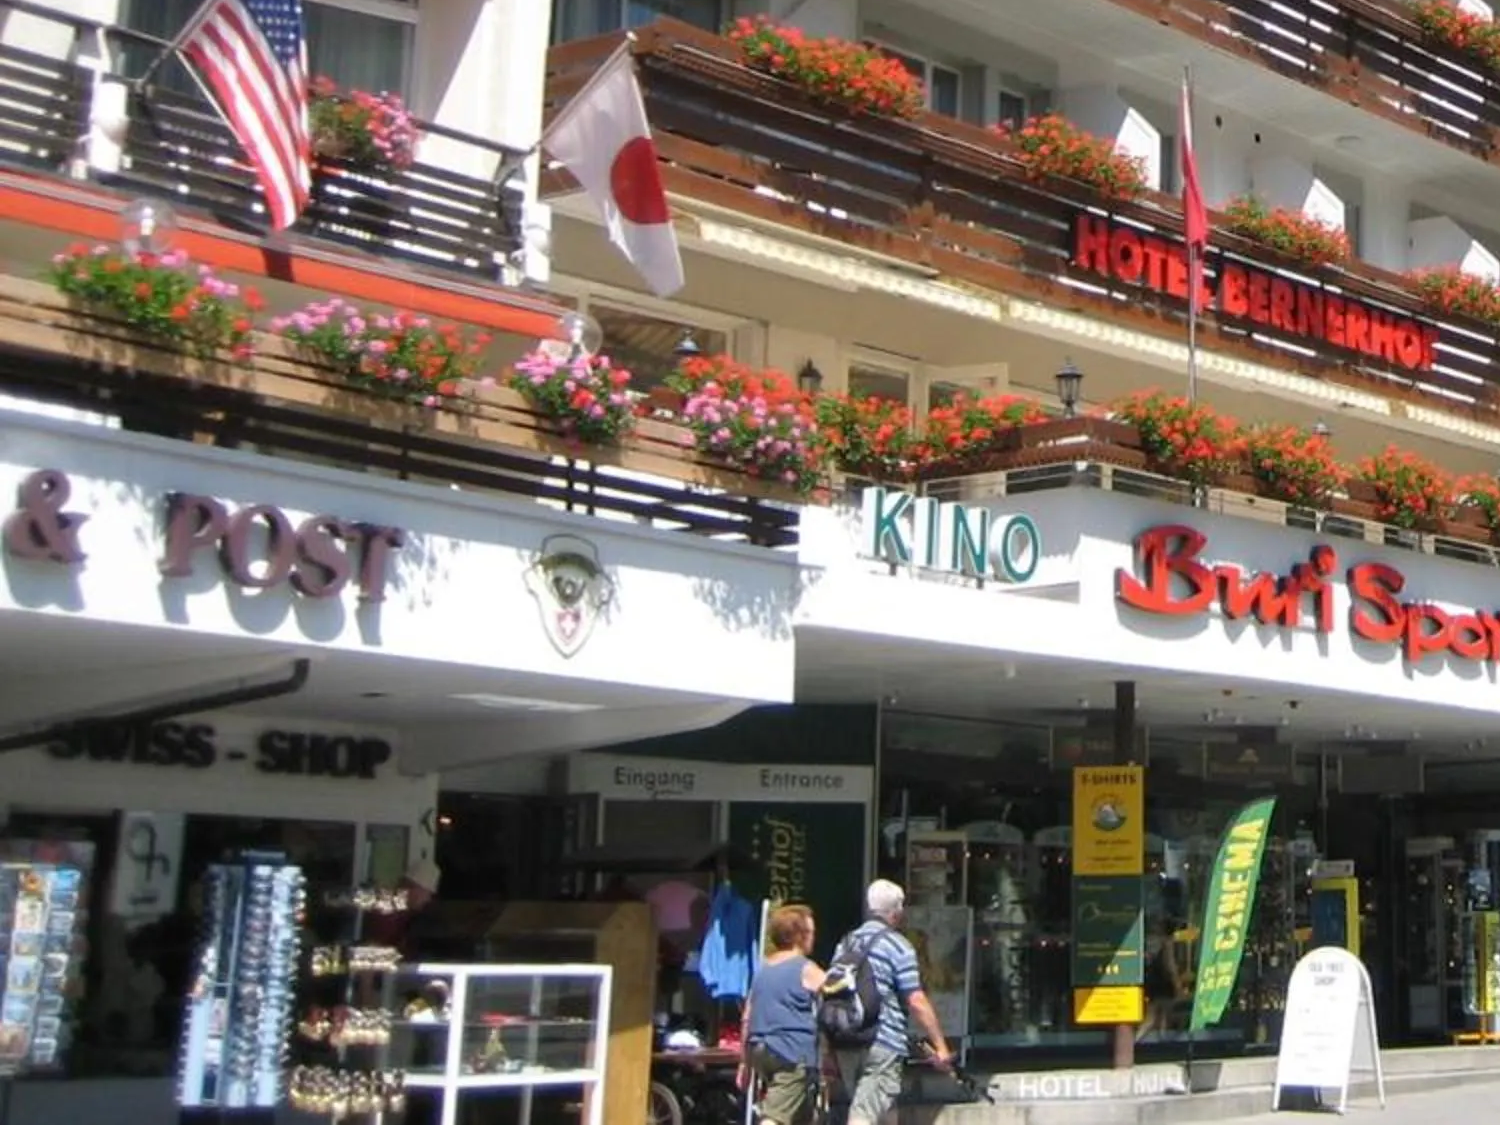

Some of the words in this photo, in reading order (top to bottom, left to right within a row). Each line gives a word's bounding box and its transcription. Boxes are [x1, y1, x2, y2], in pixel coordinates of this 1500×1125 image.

[1074, 214, 1217, 313] HOTEL
[1220, 263, 1440, 372] BERNERHOF
[3, 468, 91, 565] &
[157, 489, 404, 604] POST
[863, 486, 1041, 584] KINO
[48, 721, 216, 768] SWISS
[254, 729, 392, 779] SHOP
[613, 765, 696, 791] Eingang
[759, 768, 844, 789] Entrance
[1214, 818, 1265, 951] CINEMA
[1020, 1074, 1111, 1098] HOTEL
